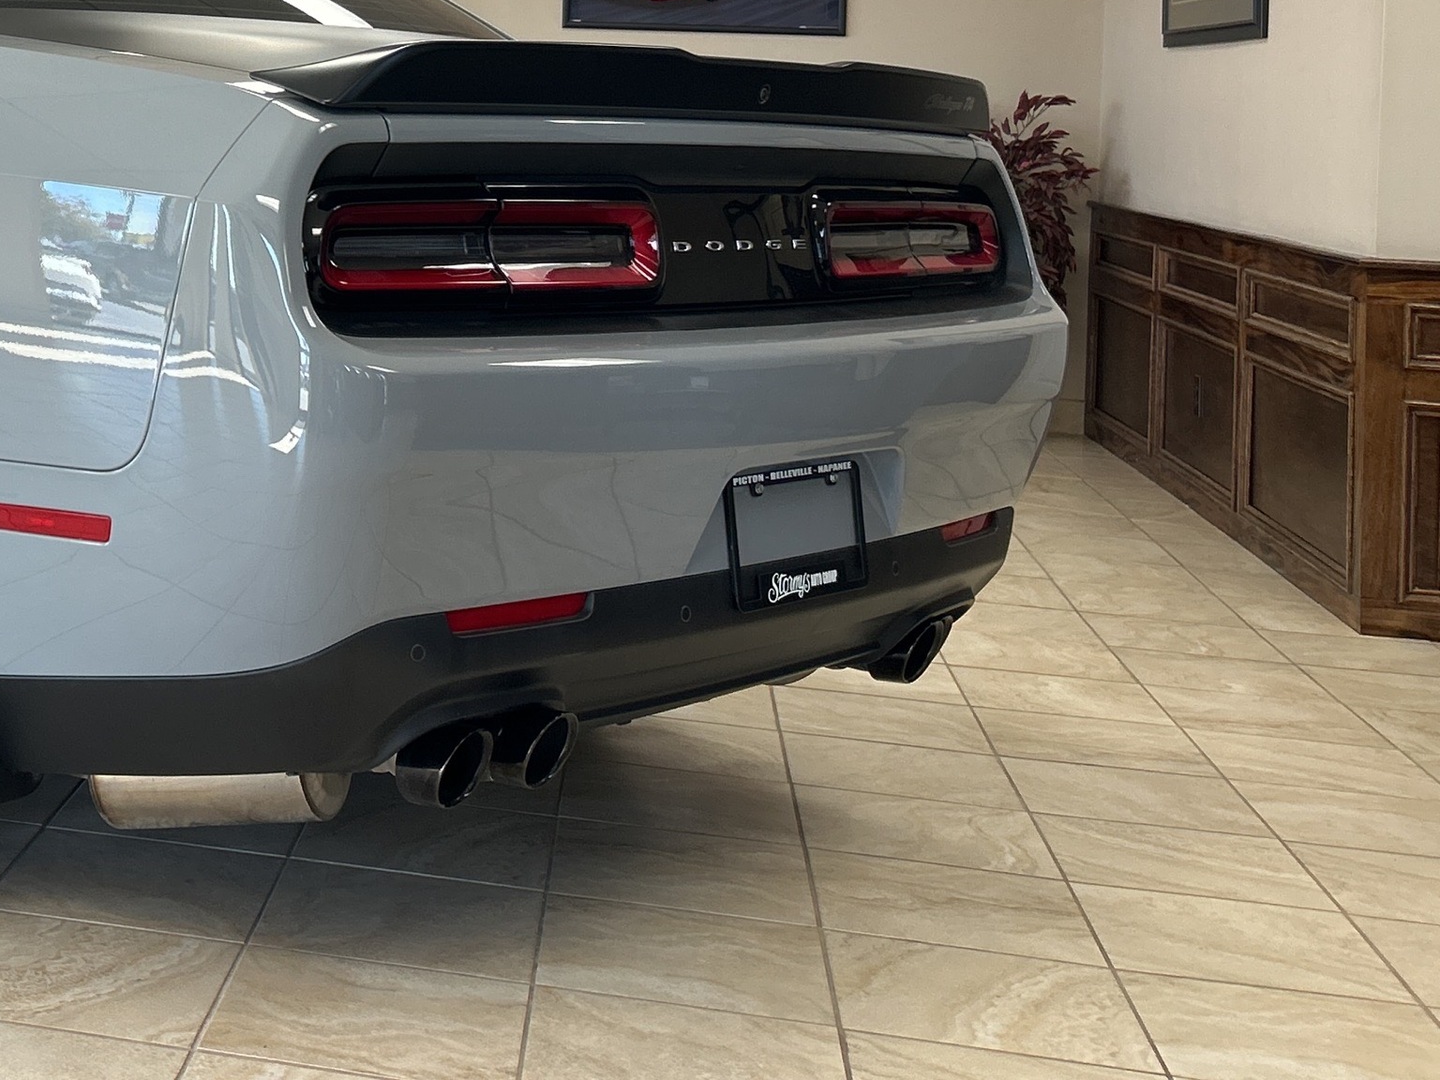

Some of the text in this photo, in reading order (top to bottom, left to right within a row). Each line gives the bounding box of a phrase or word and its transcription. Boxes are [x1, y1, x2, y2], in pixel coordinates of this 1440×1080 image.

[672, 239, 807, 252] DODGE
[732, 474, 764, 487] PICTON
[770, 466, 812, 480] BELLEVILLE
[818, 461, 852, 474] NAPANEE
